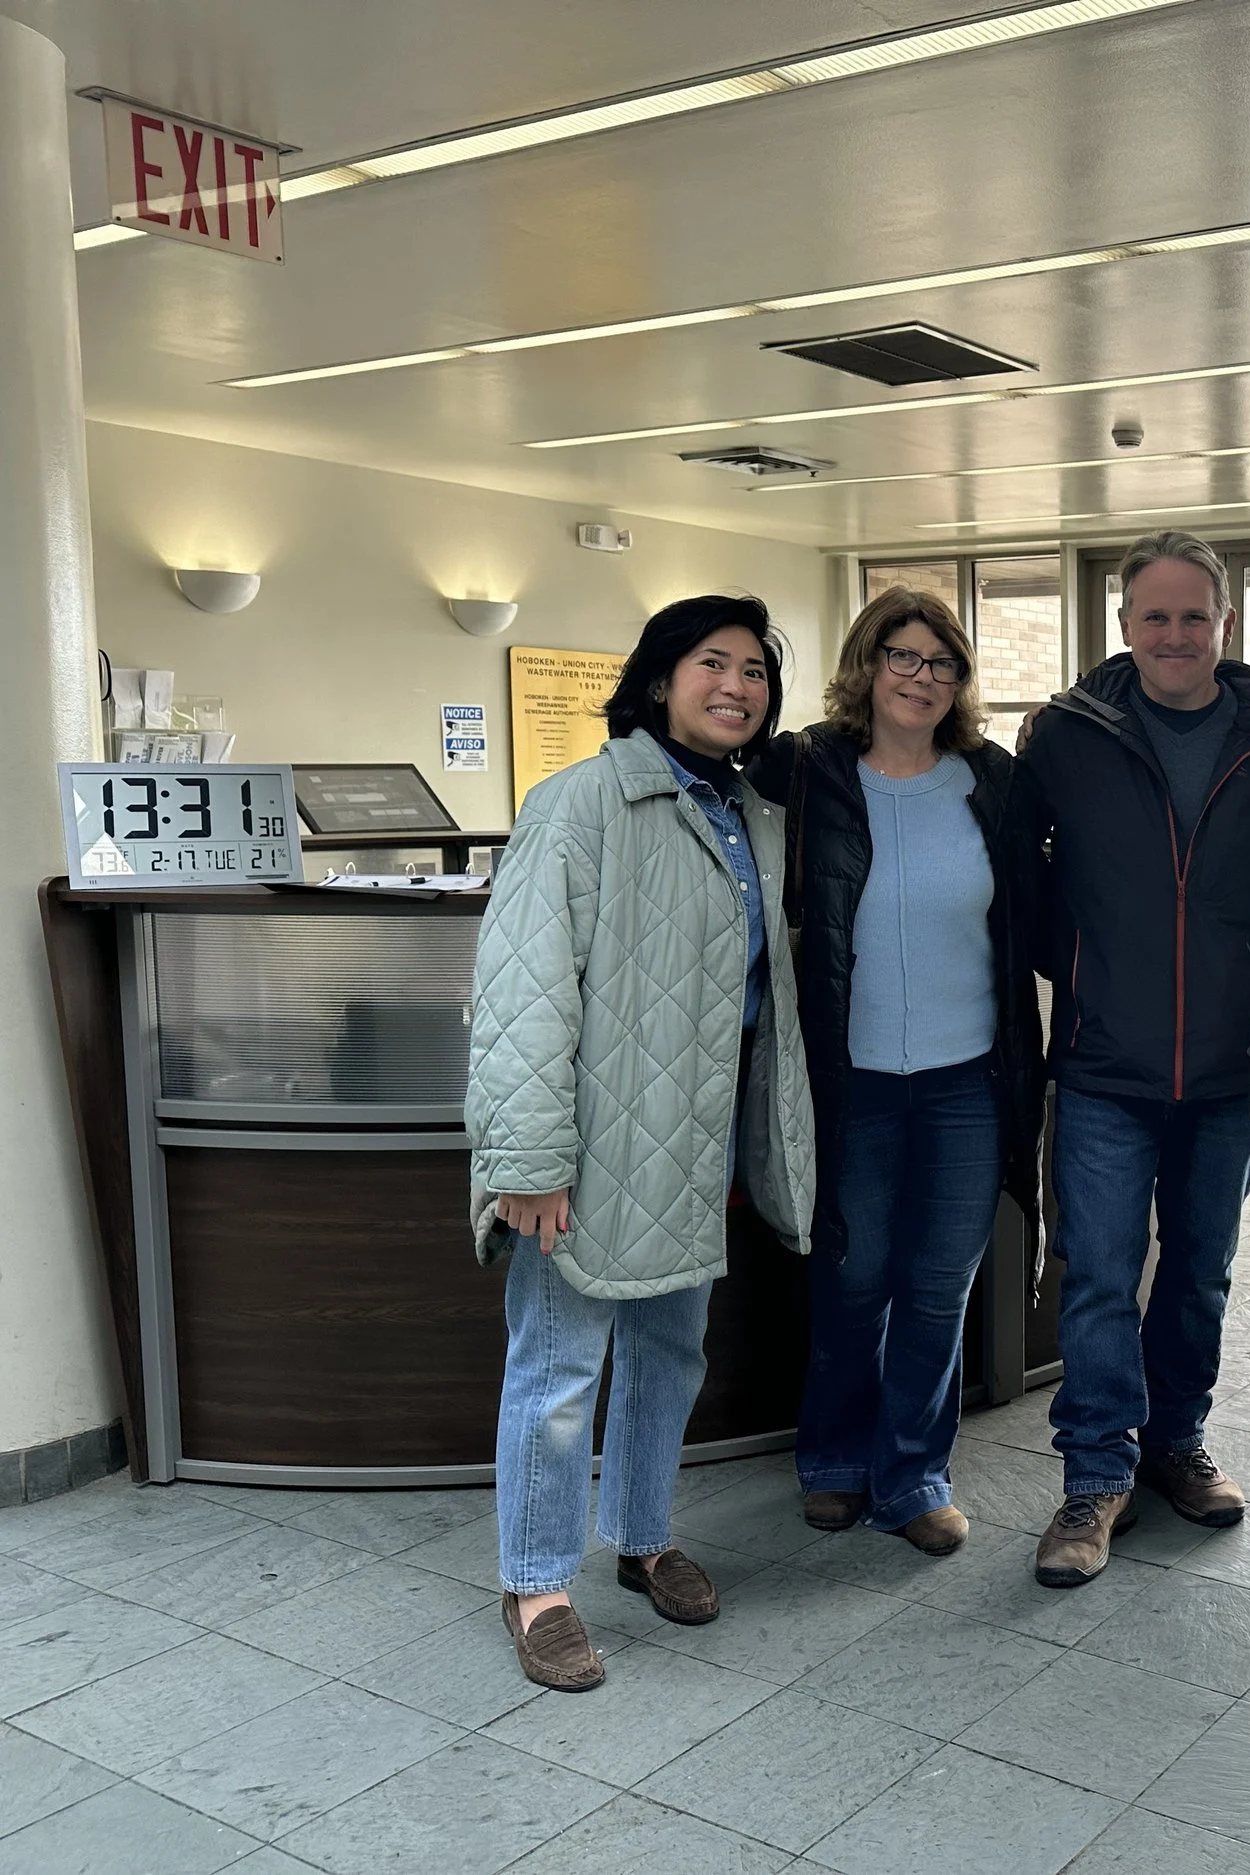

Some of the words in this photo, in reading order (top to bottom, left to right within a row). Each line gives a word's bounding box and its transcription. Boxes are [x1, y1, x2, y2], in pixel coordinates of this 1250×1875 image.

[131, 112, 264, 248] EXIT
[516, 656, 555, 666] HOBOKEN
[562, 659, 586, 669] UNION
[588, 661, 605, 670] CITY
[527, 668, 579, 678] WASTEWATER
[445, 708, 482, 719] NOTICE
[450, 739, 481, 749] AVISO
[102, 778, 253, 839] 13:31
[258, 817, 285, 837] 30
[205, 849, 236, 869] TUE
